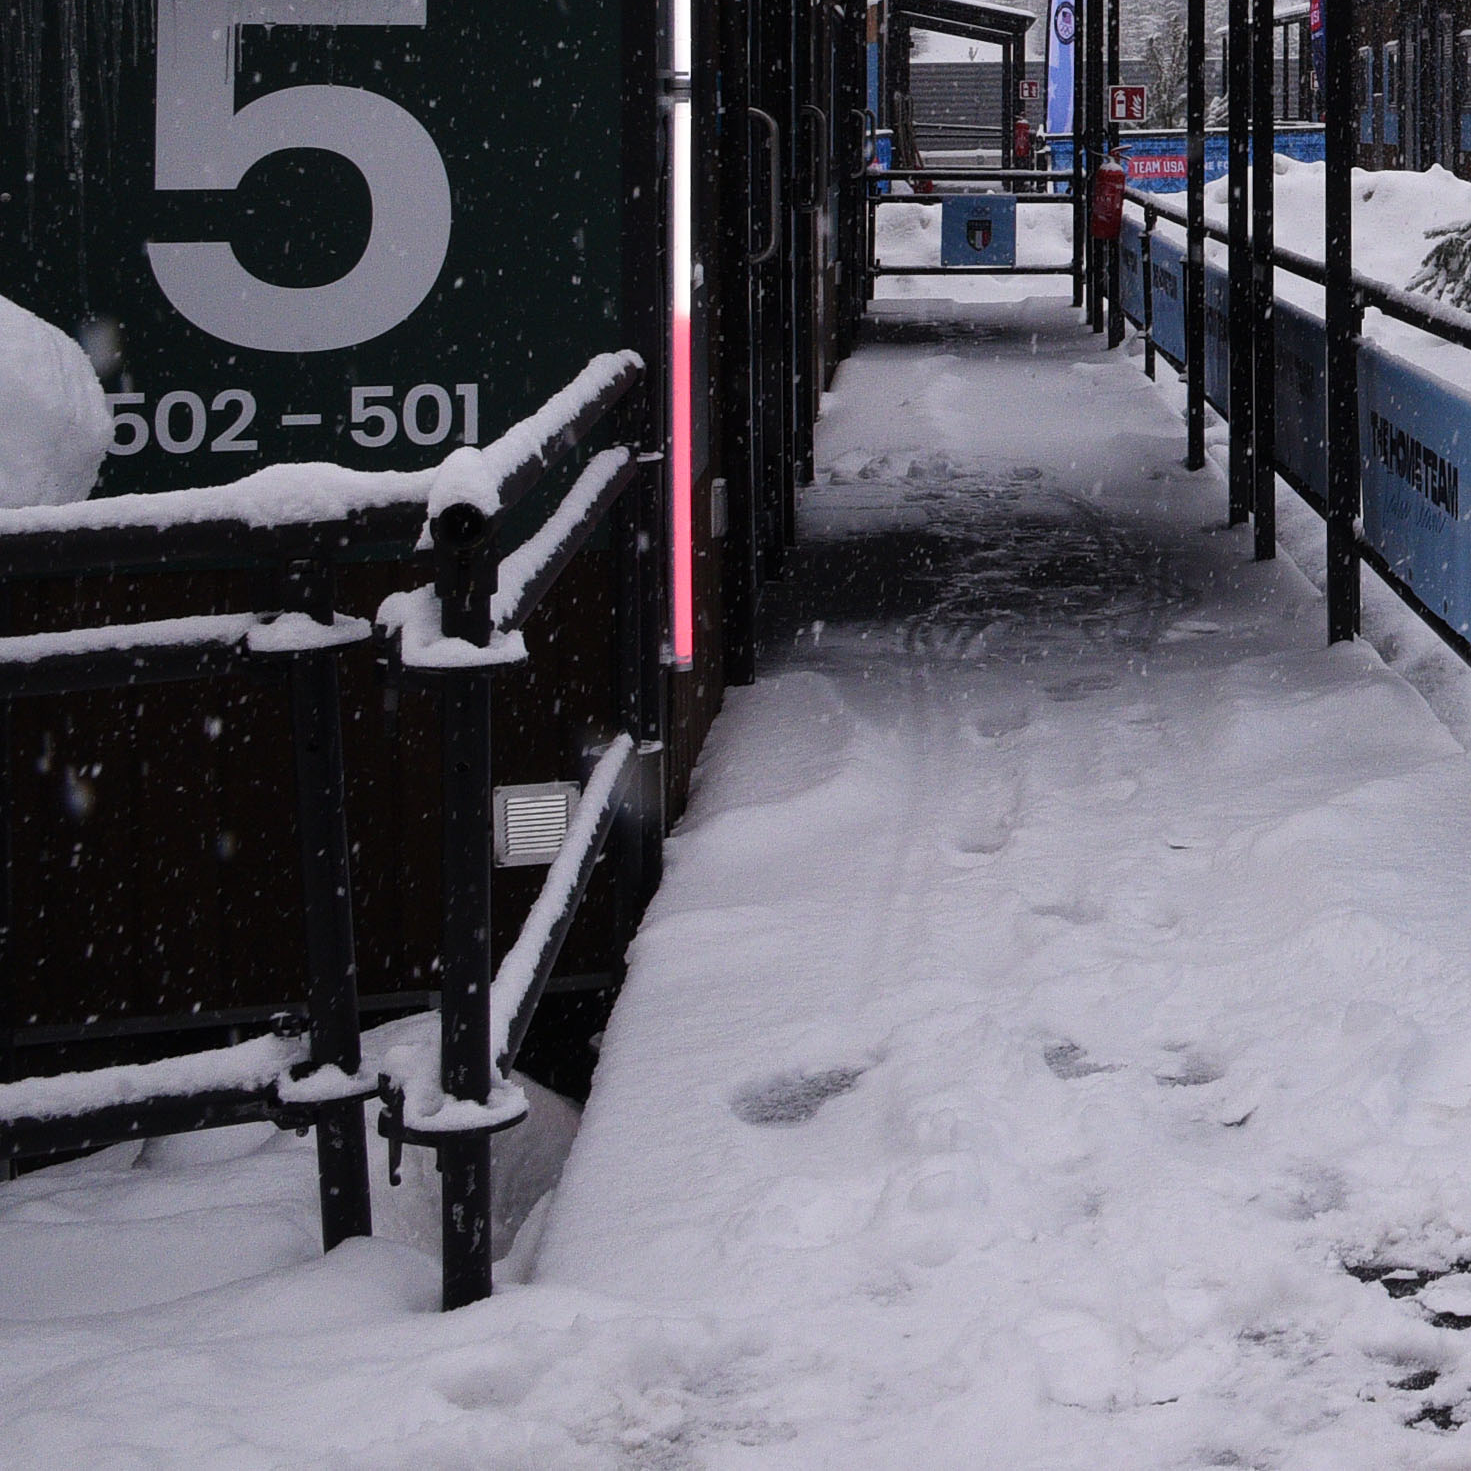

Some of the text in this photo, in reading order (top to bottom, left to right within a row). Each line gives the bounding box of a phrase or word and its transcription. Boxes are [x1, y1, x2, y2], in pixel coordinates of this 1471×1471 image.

[1133, 161, 1185, 174] TEAM USA
[106, 389, 259, 456] 502
[350, 383, 479, 448] 501
[1370, 410, 1390, 467] THE
[1423, 446, 1459, 521] TEAM
